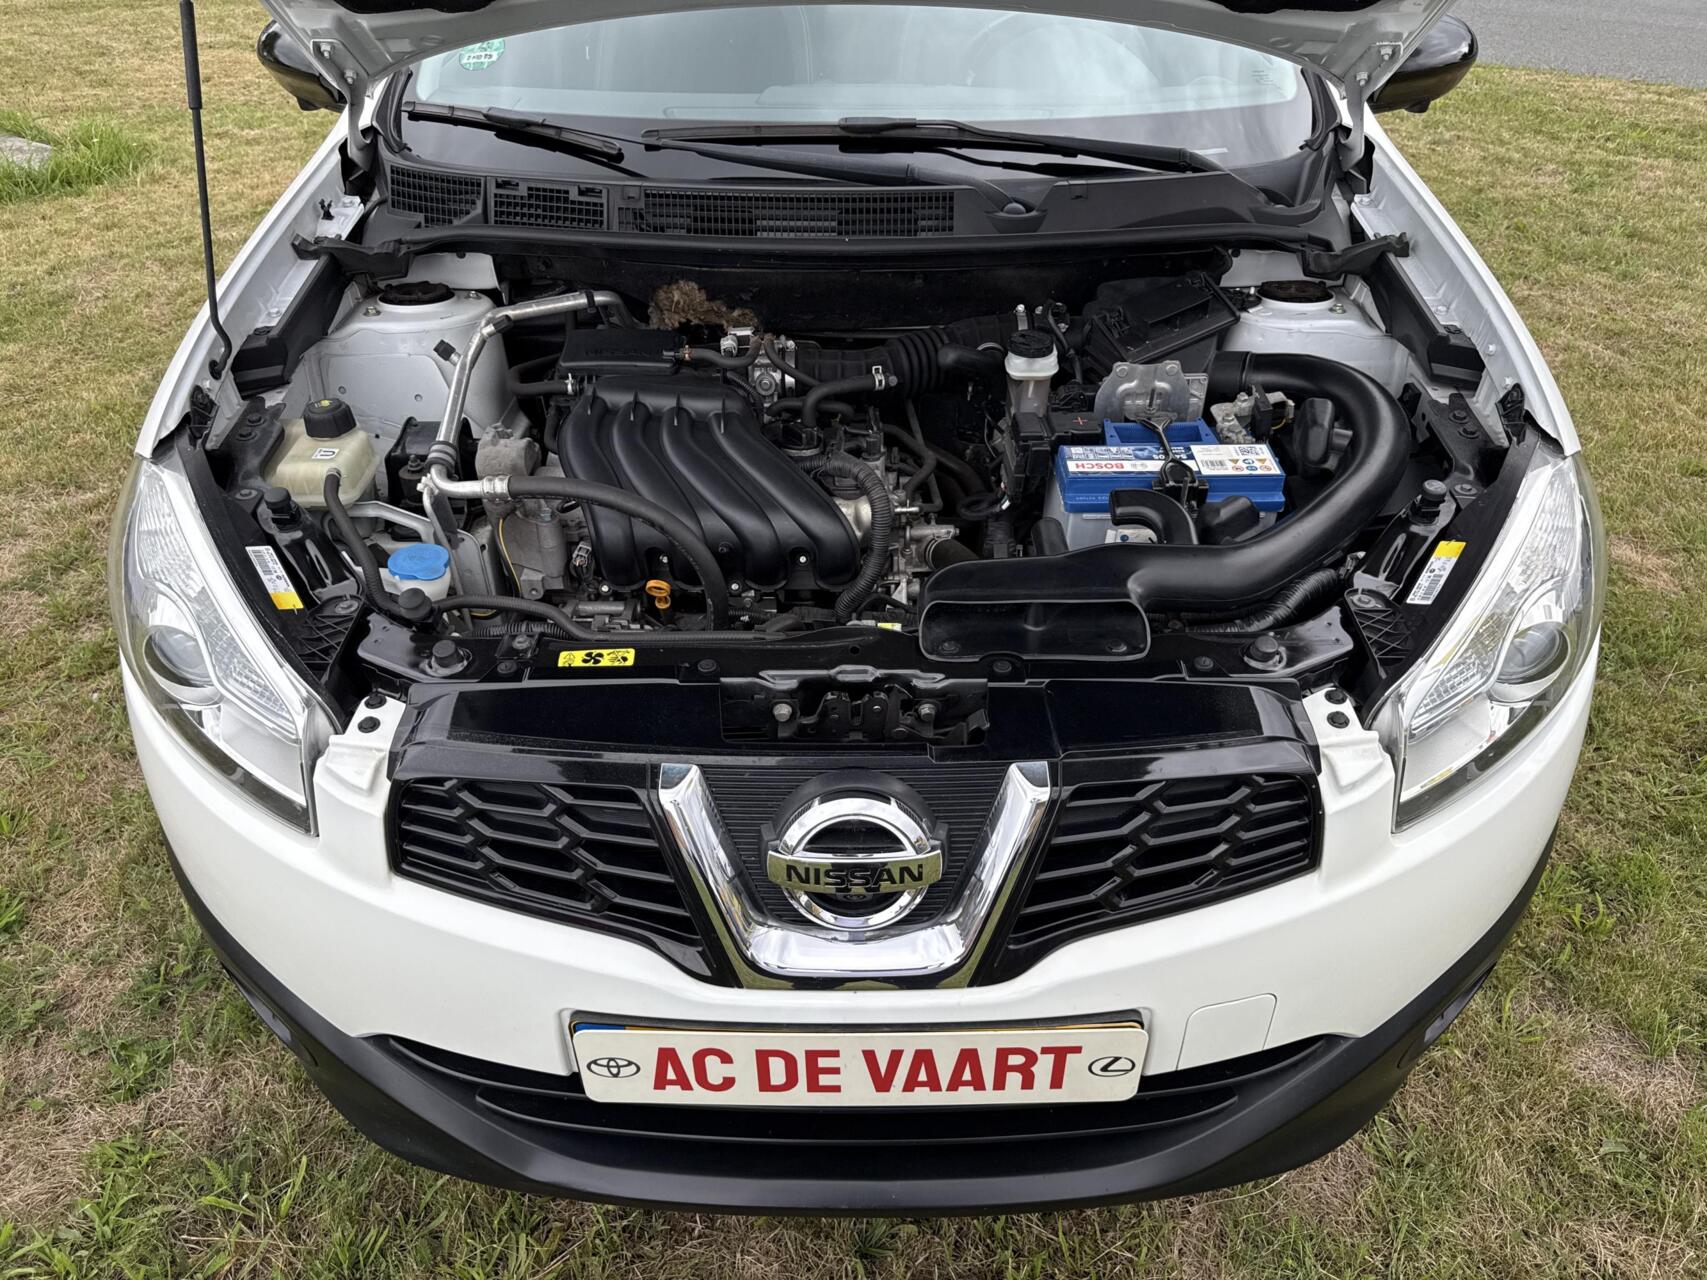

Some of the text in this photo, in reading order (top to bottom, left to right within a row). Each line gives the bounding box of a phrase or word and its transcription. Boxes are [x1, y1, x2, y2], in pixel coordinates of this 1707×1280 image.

[786, 864, 924, 887] NISSAN
[653, 1046, 1083, 1093] AC DE VAART
